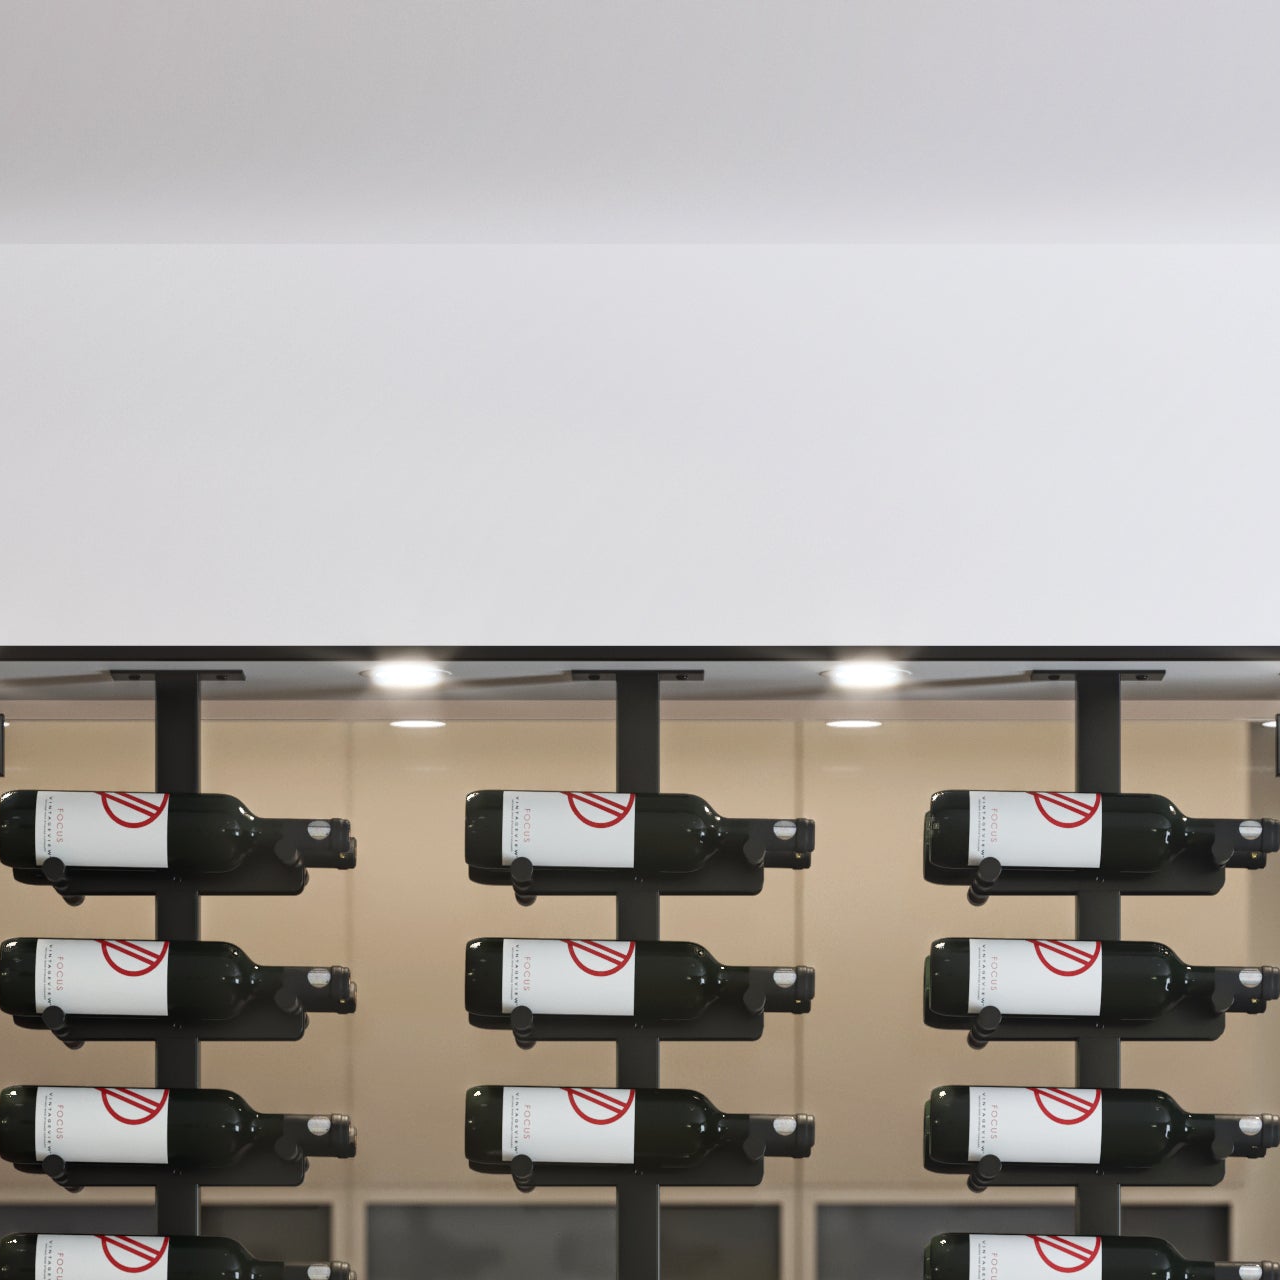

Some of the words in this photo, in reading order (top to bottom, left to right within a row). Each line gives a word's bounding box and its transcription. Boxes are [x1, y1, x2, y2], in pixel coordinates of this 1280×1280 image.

[523, 808, 531, 843] FOCUS
[990, 808, 998, 843] FOCUS
[523, 956, 531, 991] FOCUS
[990, 956, 998, 991] FOCUS
[523, 1104, 531, 1139] FOCUS
[990, 1104, 998, 1139] FOCUS
